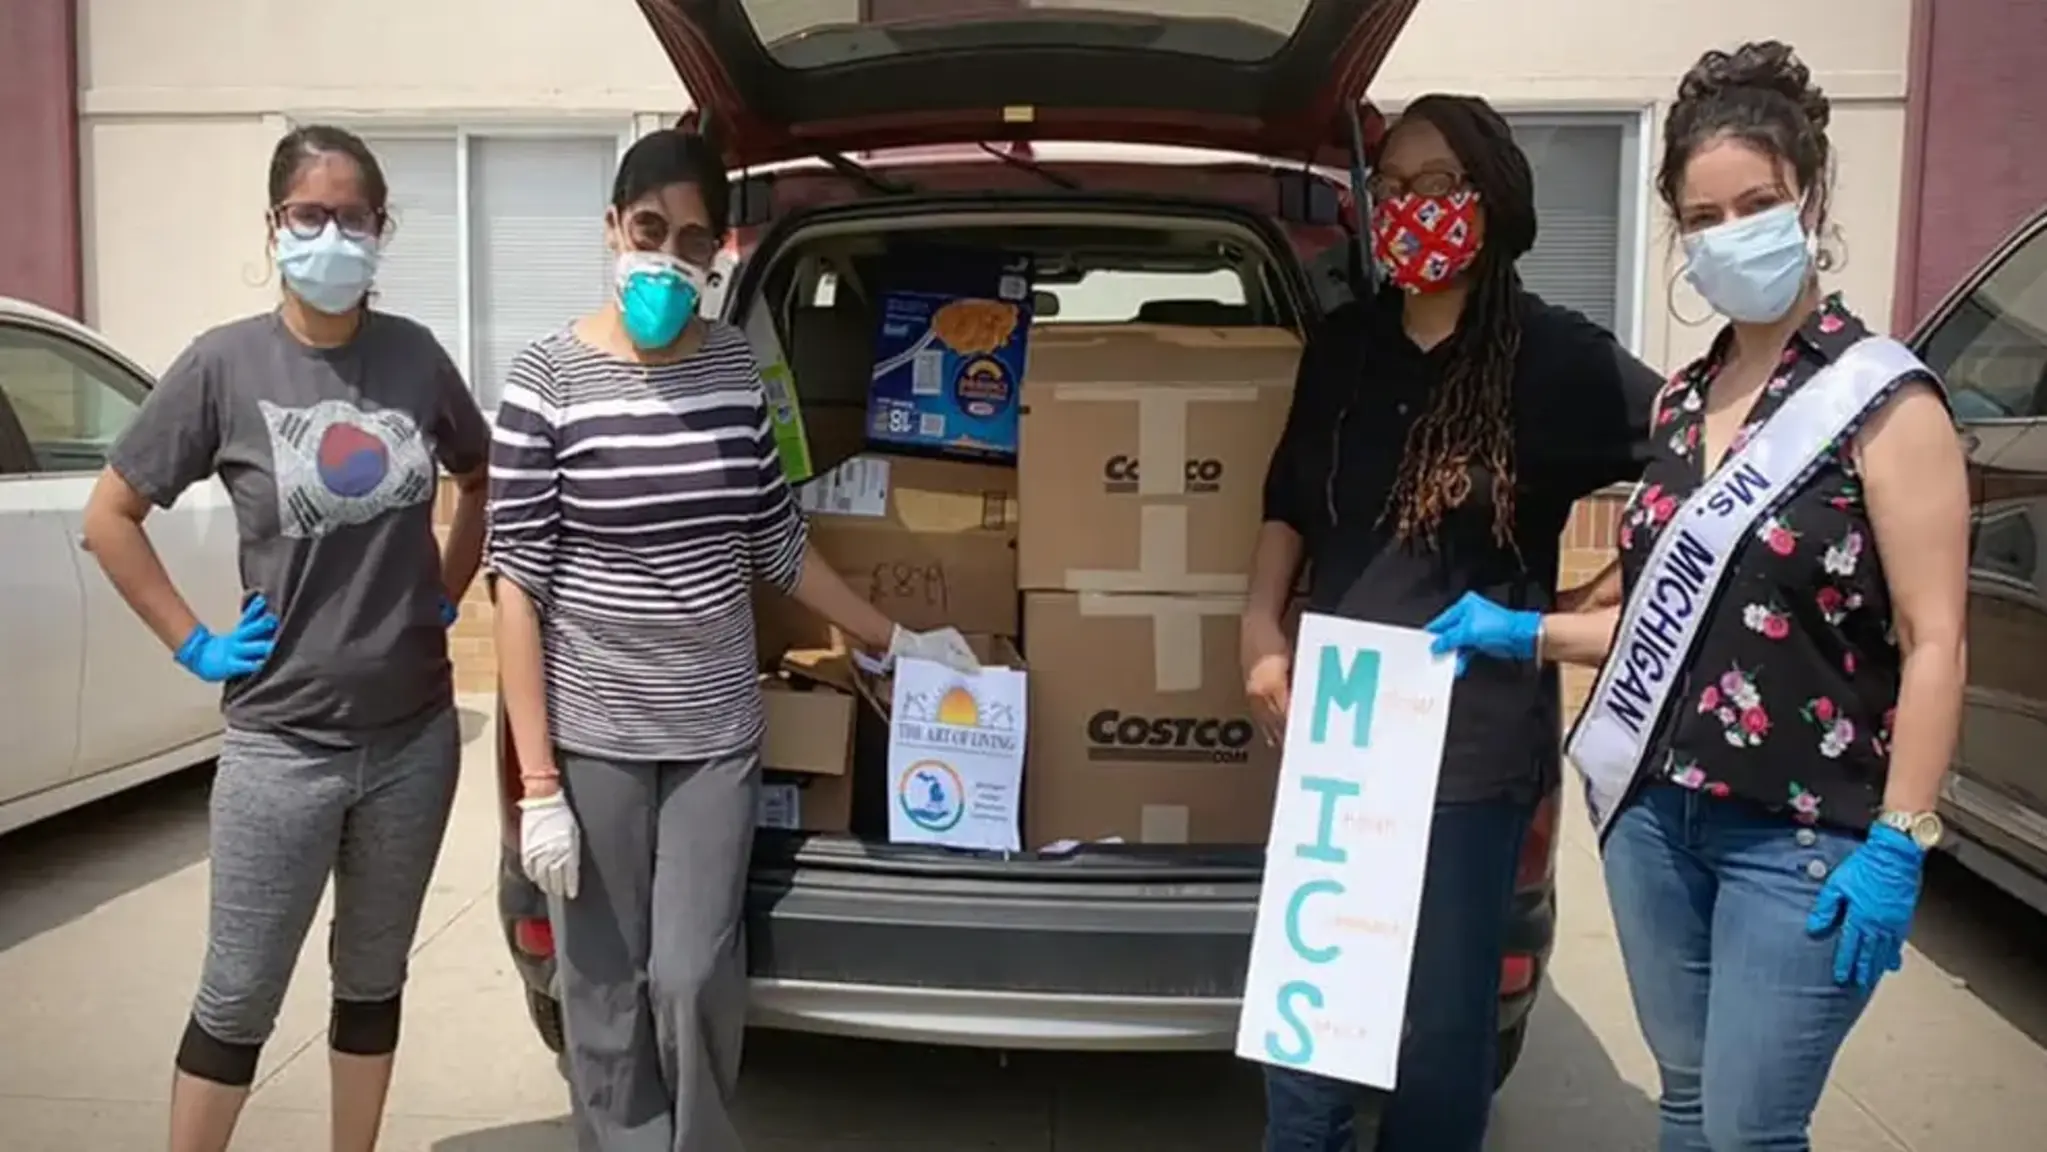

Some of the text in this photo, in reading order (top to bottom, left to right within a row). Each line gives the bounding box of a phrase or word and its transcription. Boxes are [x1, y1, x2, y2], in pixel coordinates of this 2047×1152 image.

[890, 409, 911, 431] 18
[1606, 464, 1771, 734] Ms. MICHIGAN
[898, 723, 1015, 751] THE ART OF LIVING
